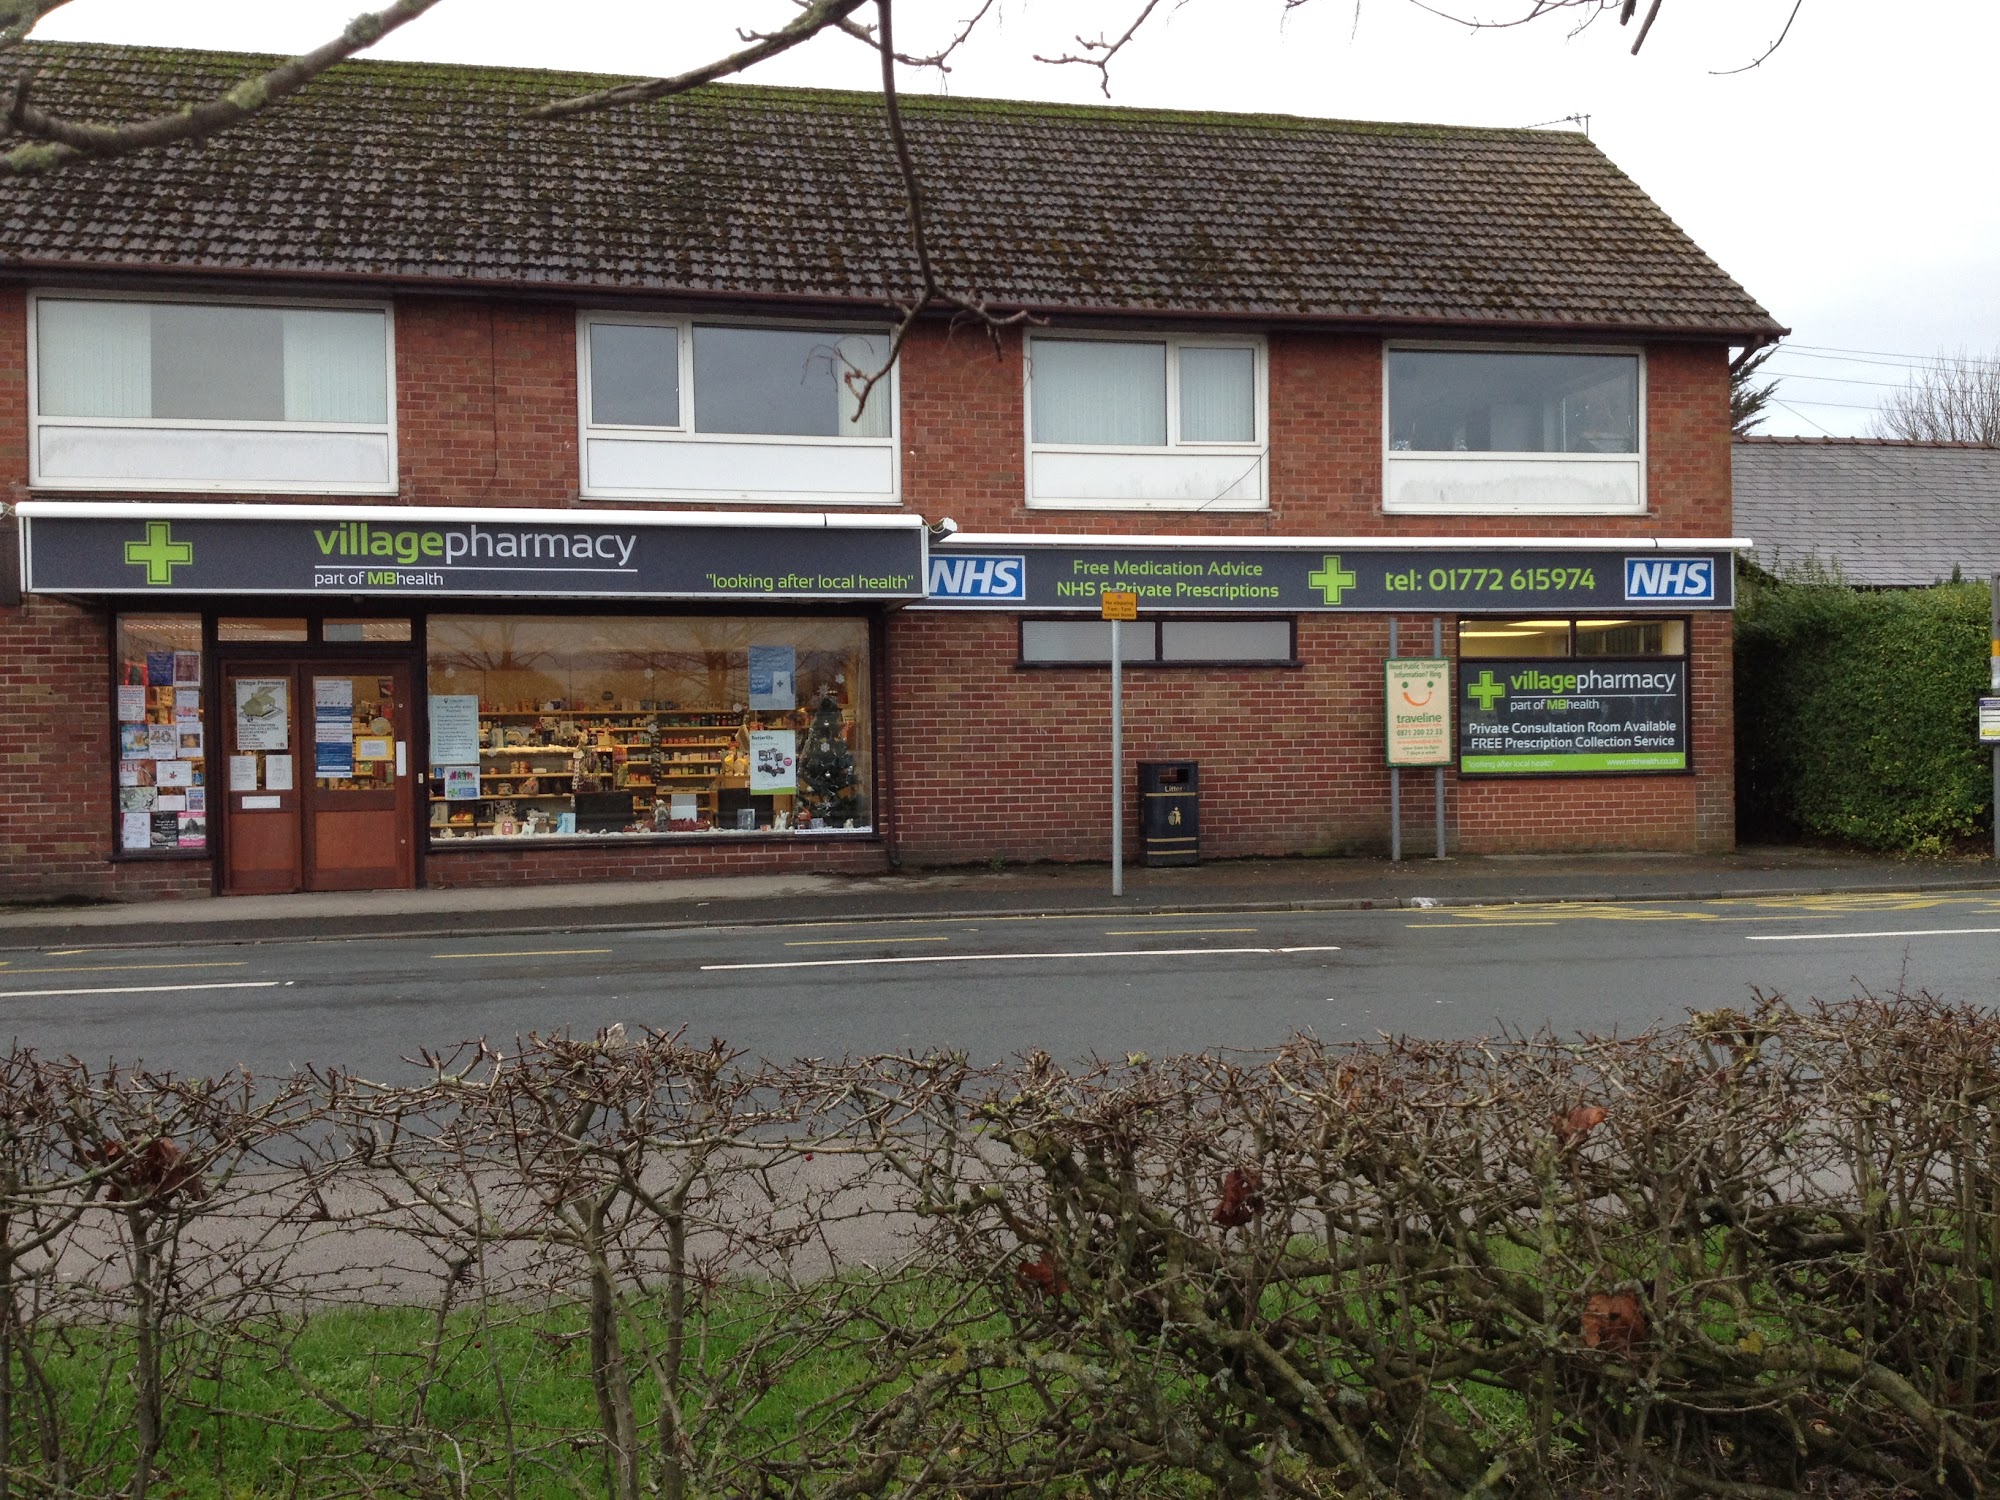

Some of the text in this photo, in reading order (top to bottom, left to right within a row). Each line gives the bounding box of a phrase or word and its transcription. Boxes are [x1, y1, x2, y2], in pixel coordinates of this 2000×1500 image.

[314, 522, 637, 567] villagepharmacy
[1074, 560, 1263, 576] Free Medication Advice
[315, 571, 444, 587] part of MBhealth
[706, 574, 914, 591] "looking after local health"
[929, 559, 1019, 595] NHS
[1385, 568, 1596, 591] tel: 01772 615974
[1630, 563, 1708, 595] NHS
[1057, 582, 1279, 600] NHS & Private Prescriptions
[1421, 663, 1446, 671] Transport
[1394, 671, 1441, 679] Information? Ring
[1510, 669, 1676, 693] villagepharmacy
[1510, 700, 1532, 713] part
[1533, 699, 1545, 710] of
[1396, 712, 1442, 723] traveline
[1469, 720, 1676, 735] Private Consultation Room Available
[1471, 735, 1675, 750] FREE Prescription Collection Service
[120, 764, 138, 773] FLU
[1496, 759, 1512, 768] after
[1164, 785, 1183, 793] Litter
